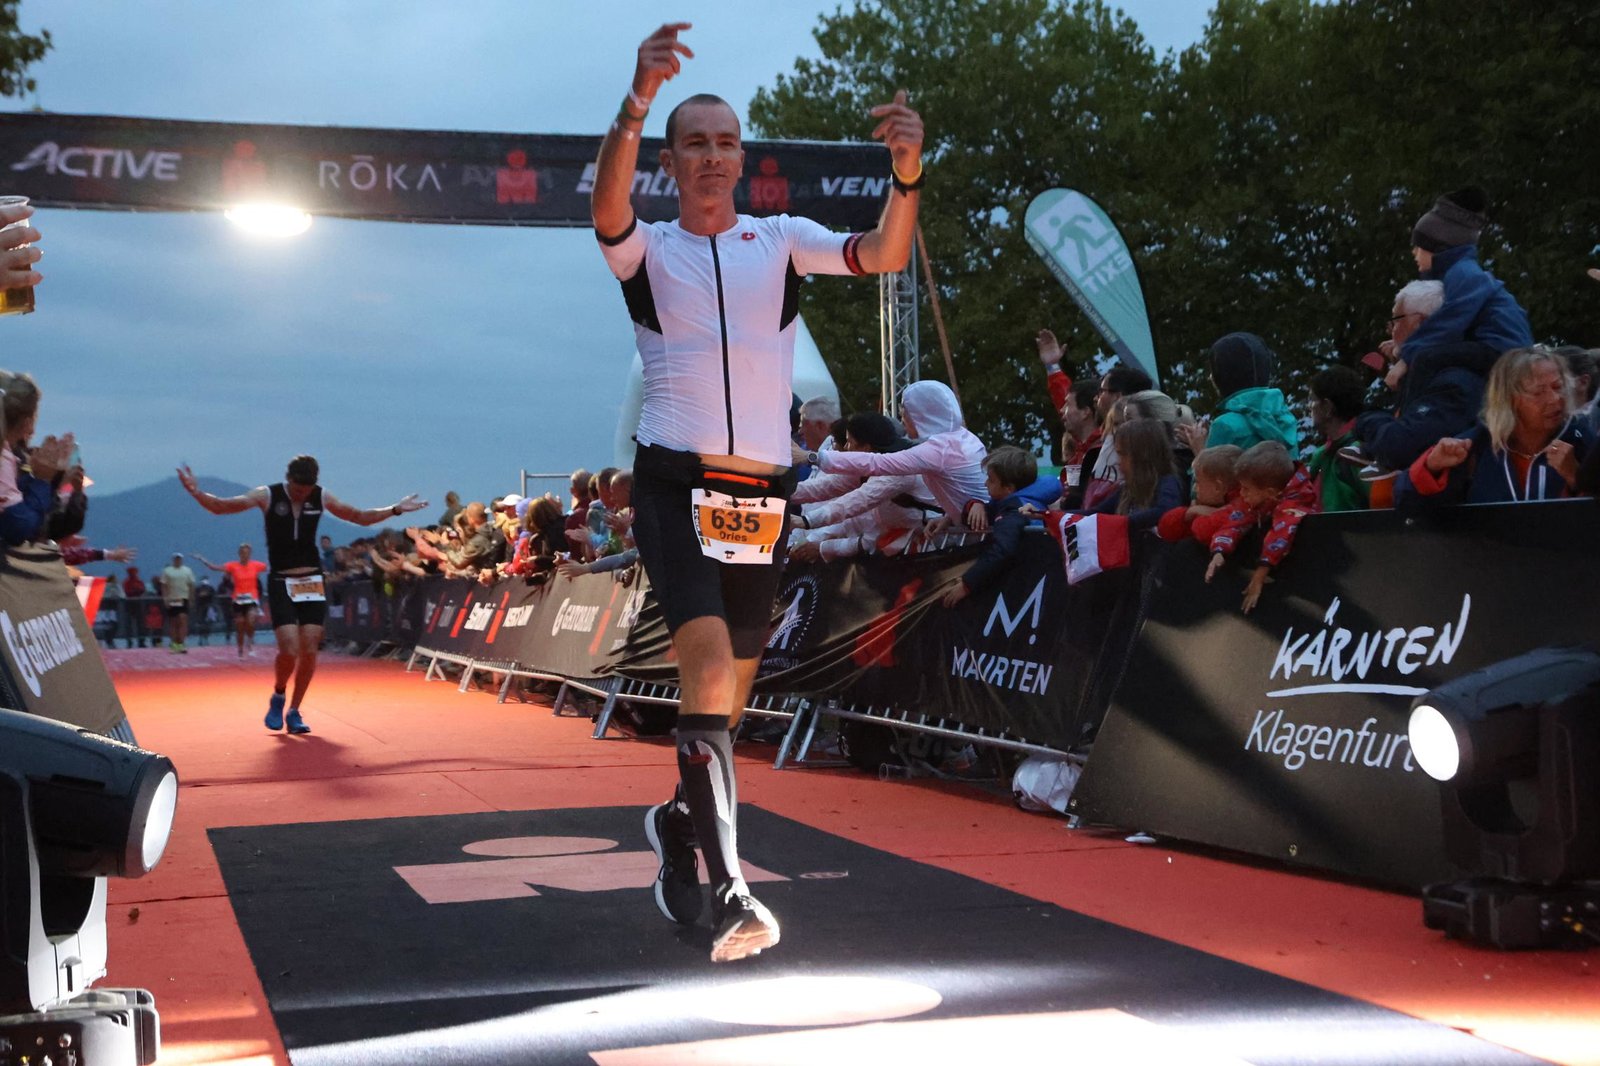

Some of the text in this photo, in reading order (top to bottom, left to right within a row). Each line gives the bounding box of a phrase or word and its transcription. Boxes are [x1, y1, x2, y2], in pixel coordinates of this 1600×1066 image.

[11, 140, 183, 182] ACTIVE
[821, 176, 893, 197] VEN
[711, 508, 760, 533] 635
[1269, 593, 1471, 682] KÄRNTEN
[952, 646, 1053, 696] MAURTEN
